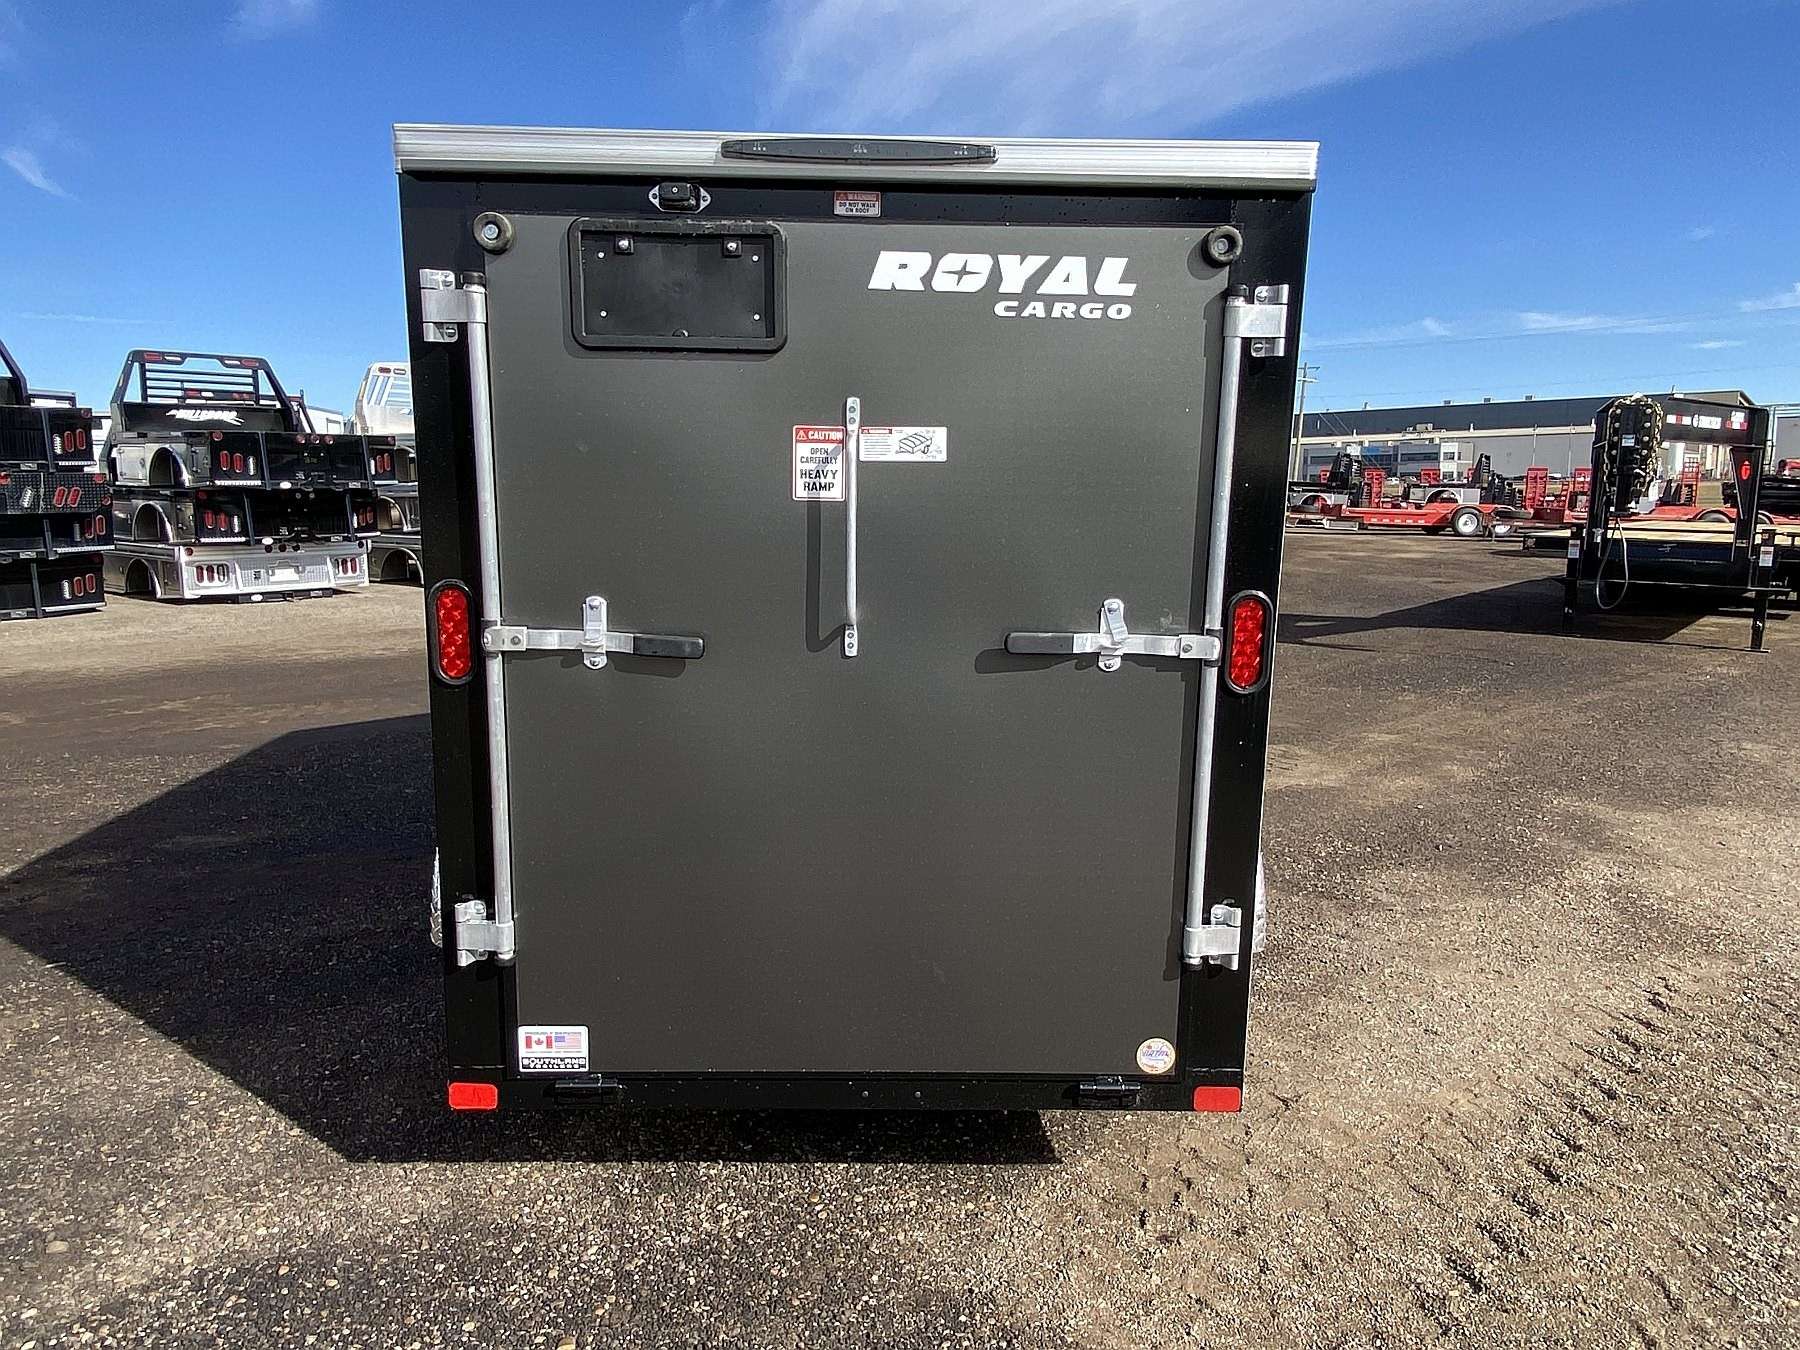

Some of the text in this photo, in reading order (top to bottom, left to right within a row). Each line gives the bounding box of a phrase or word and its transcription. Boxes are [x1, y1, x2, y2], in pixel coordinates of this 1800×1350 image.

[867, 250, 1137, 297] ROYAL
[993, 300, 1132, 320] CARGO
[808, 430, 843, 441] CAUTION
[810, 447, 829, 456] OPEN
[800, 456, 838, 465] CAREFULLY
[800, 468, 839, 480] HEAVY
[803, 481, 835, 492] RAMP
